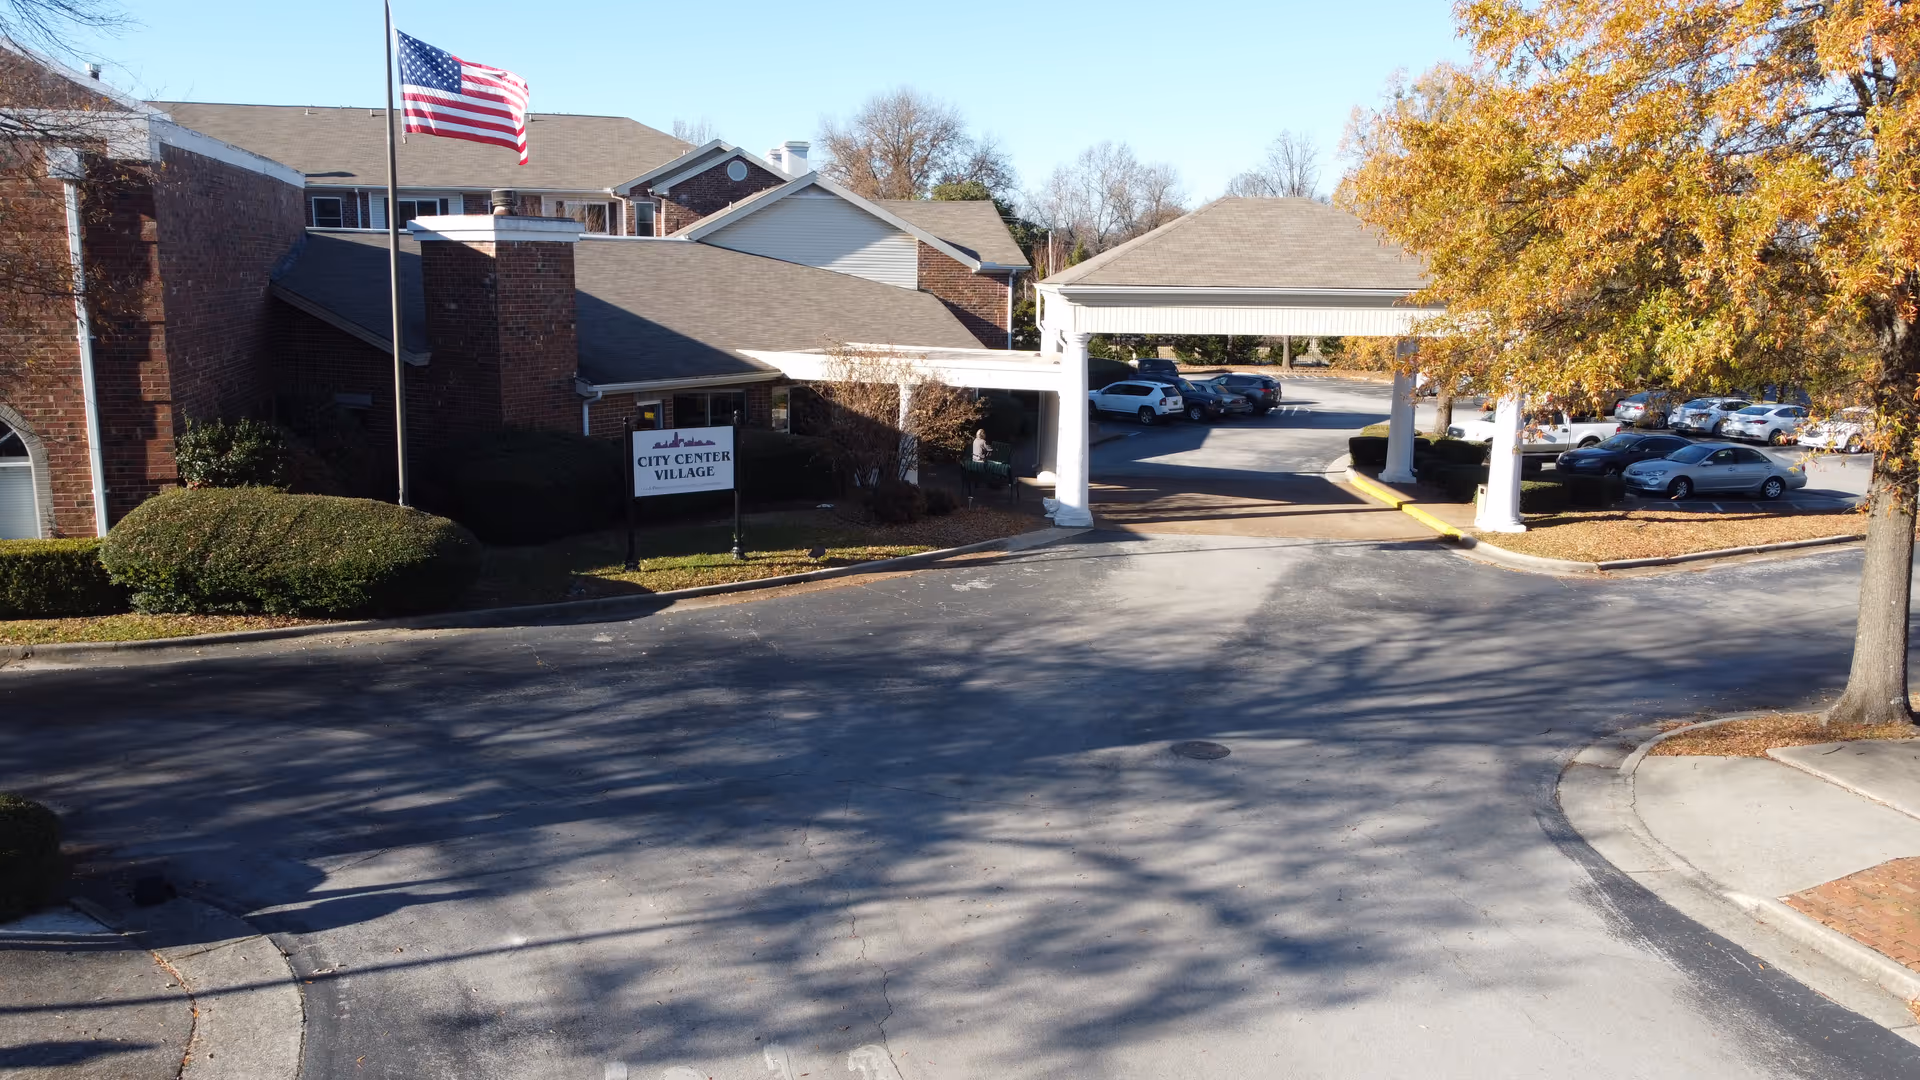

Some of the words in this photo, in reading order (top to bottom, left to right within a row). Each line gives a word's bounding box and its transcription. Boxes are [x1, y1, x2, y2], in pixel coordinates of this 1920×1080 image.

[637, 455, 671, 468] CITY
[674, 451, 731, 465] CENTER
[654, 466, 715, 480] VILLAGE
